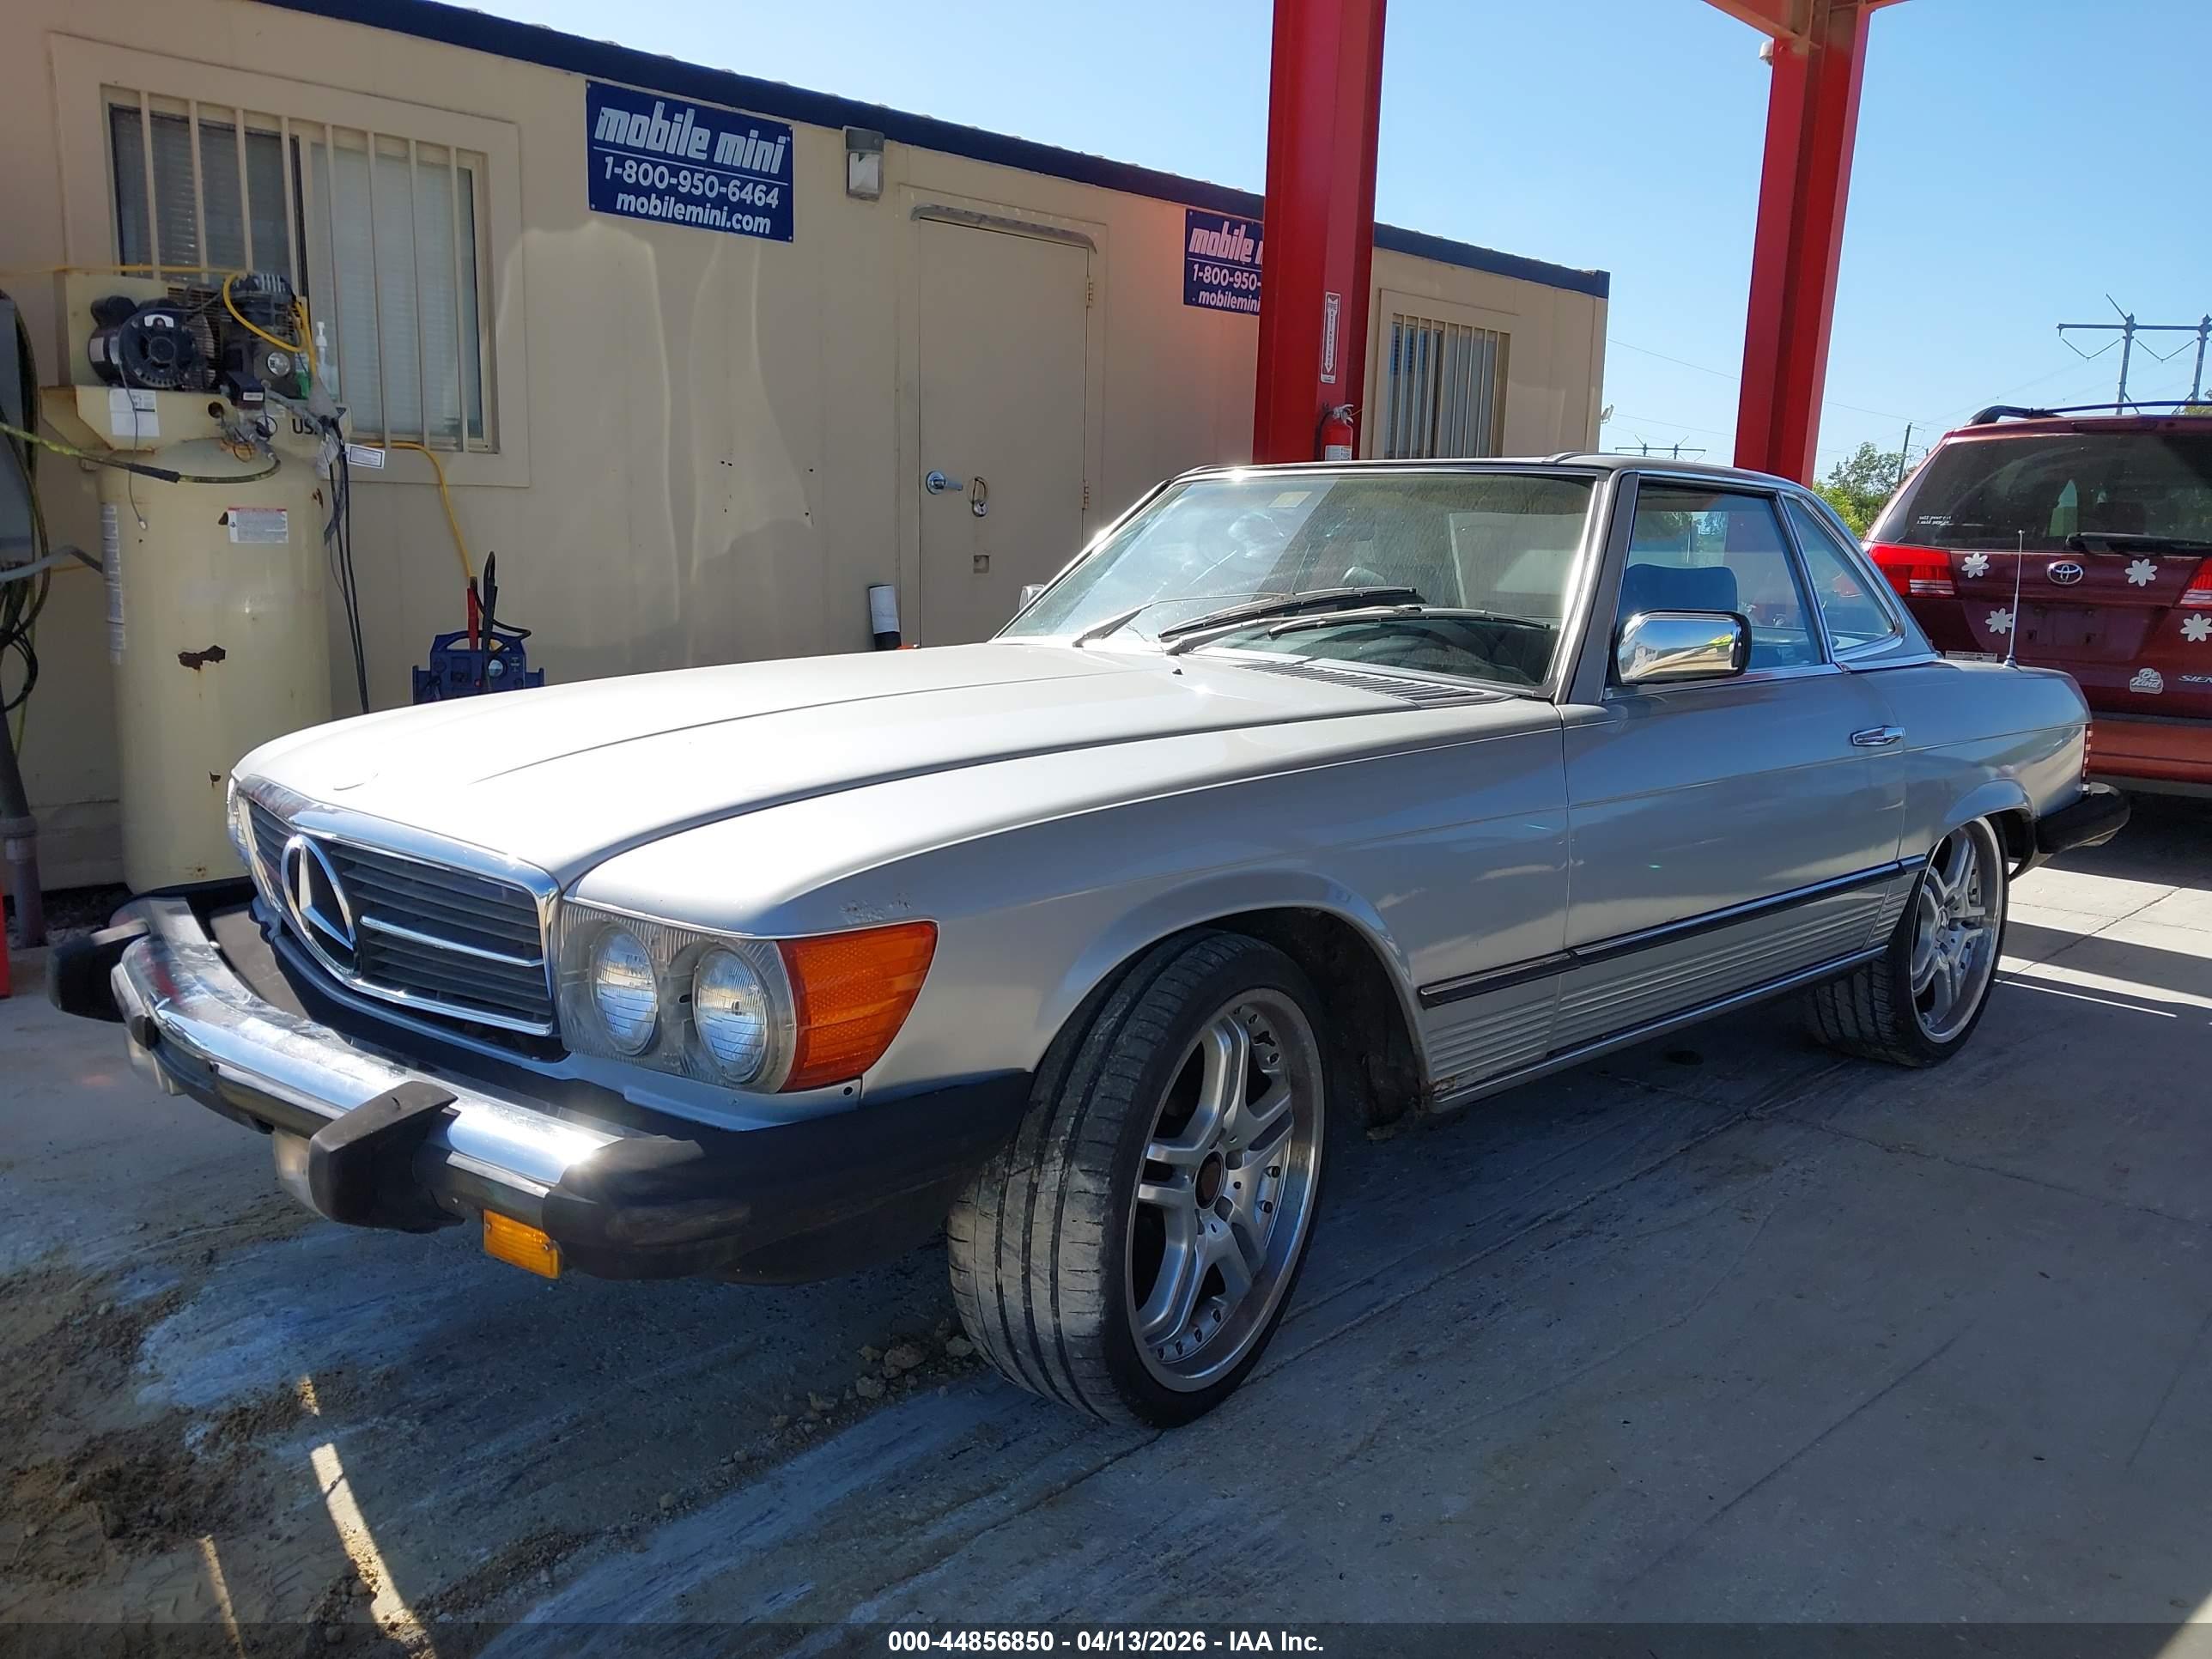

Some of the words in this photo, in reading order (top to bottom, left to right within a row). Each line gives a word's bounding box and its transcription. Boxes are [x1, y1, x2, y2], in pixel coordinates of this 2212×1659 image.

[594, 101, 711, 160] mobile
[714, 130, 787, 174] mini
[605, 156, 779, 209] 1-800-950-6464
[616, 191, 771, 234] mobilemini.com
[1188, 221, 1255, 263] mobile
